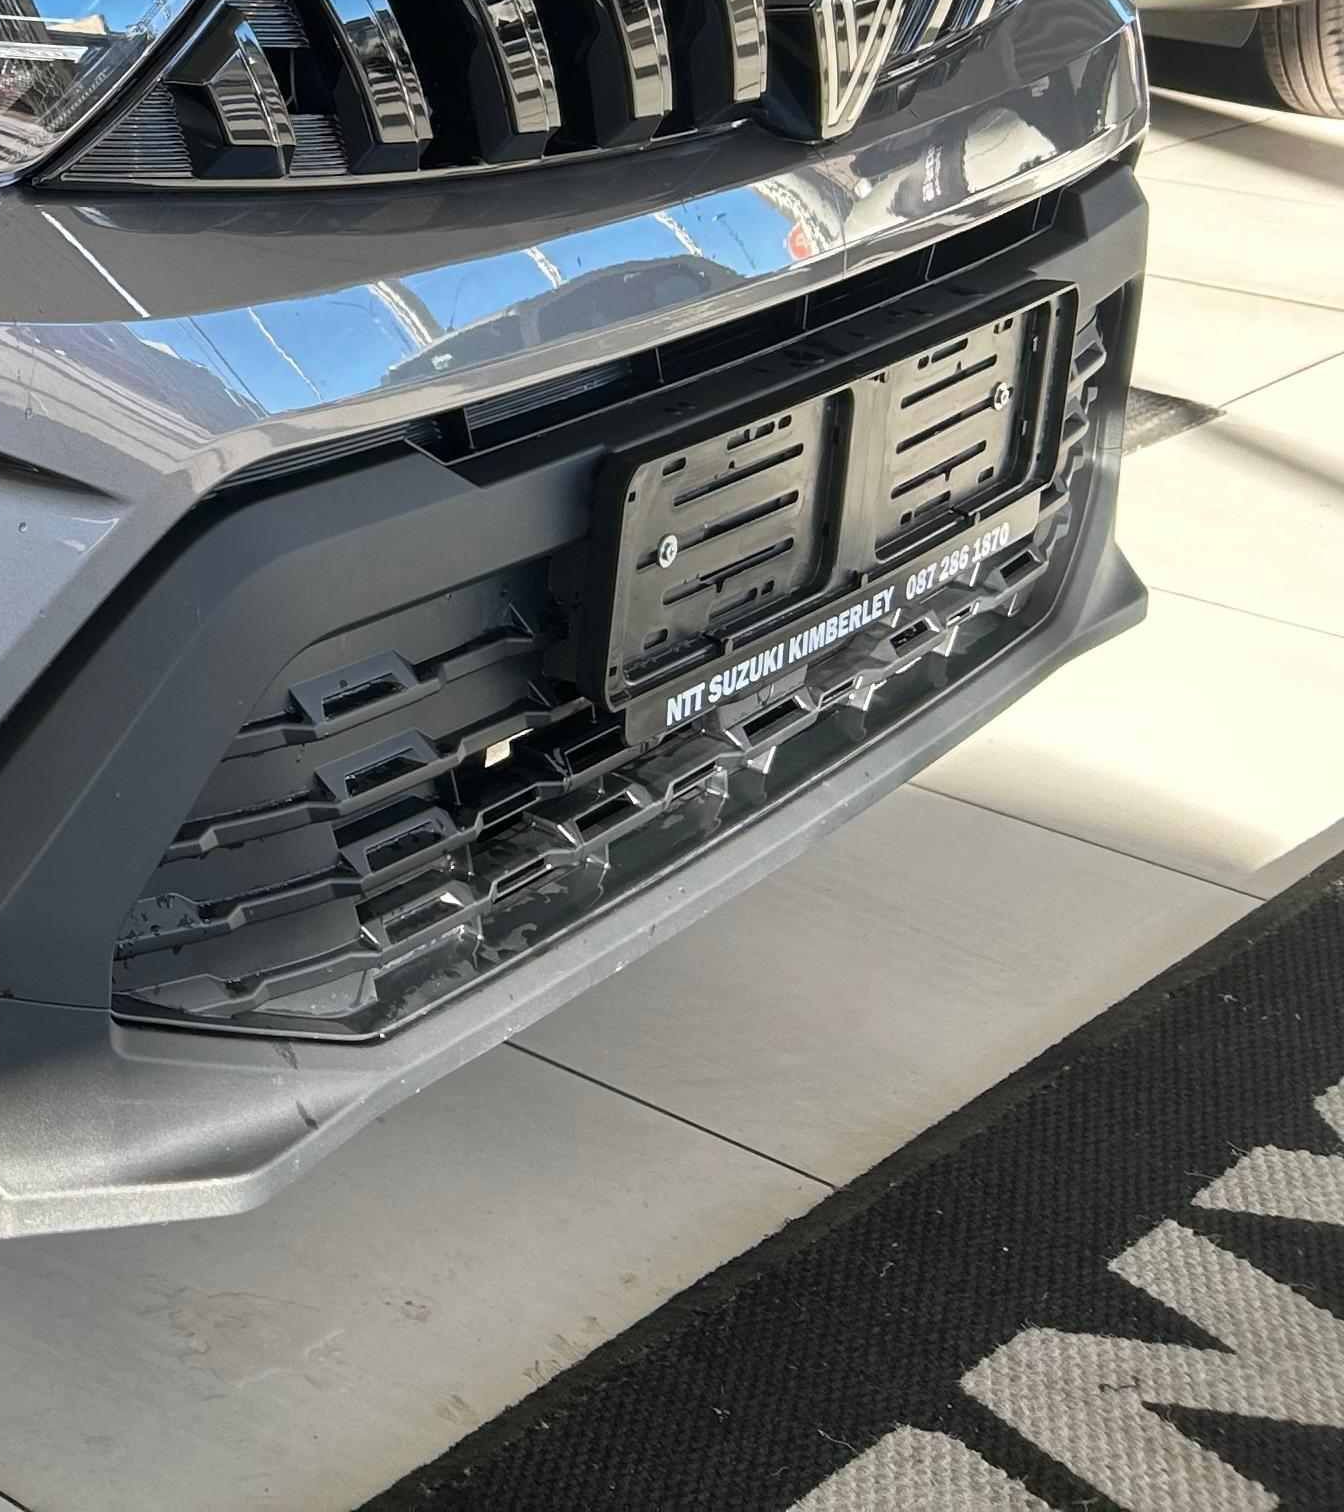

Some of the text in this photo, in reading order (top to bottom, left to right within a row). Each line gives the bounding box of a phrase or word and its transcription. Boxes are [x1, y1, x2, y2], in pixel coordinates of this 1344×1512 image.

[666, 523, 1009, 727] NTT SUZUKI KIMBERLEY 087 286 1870
